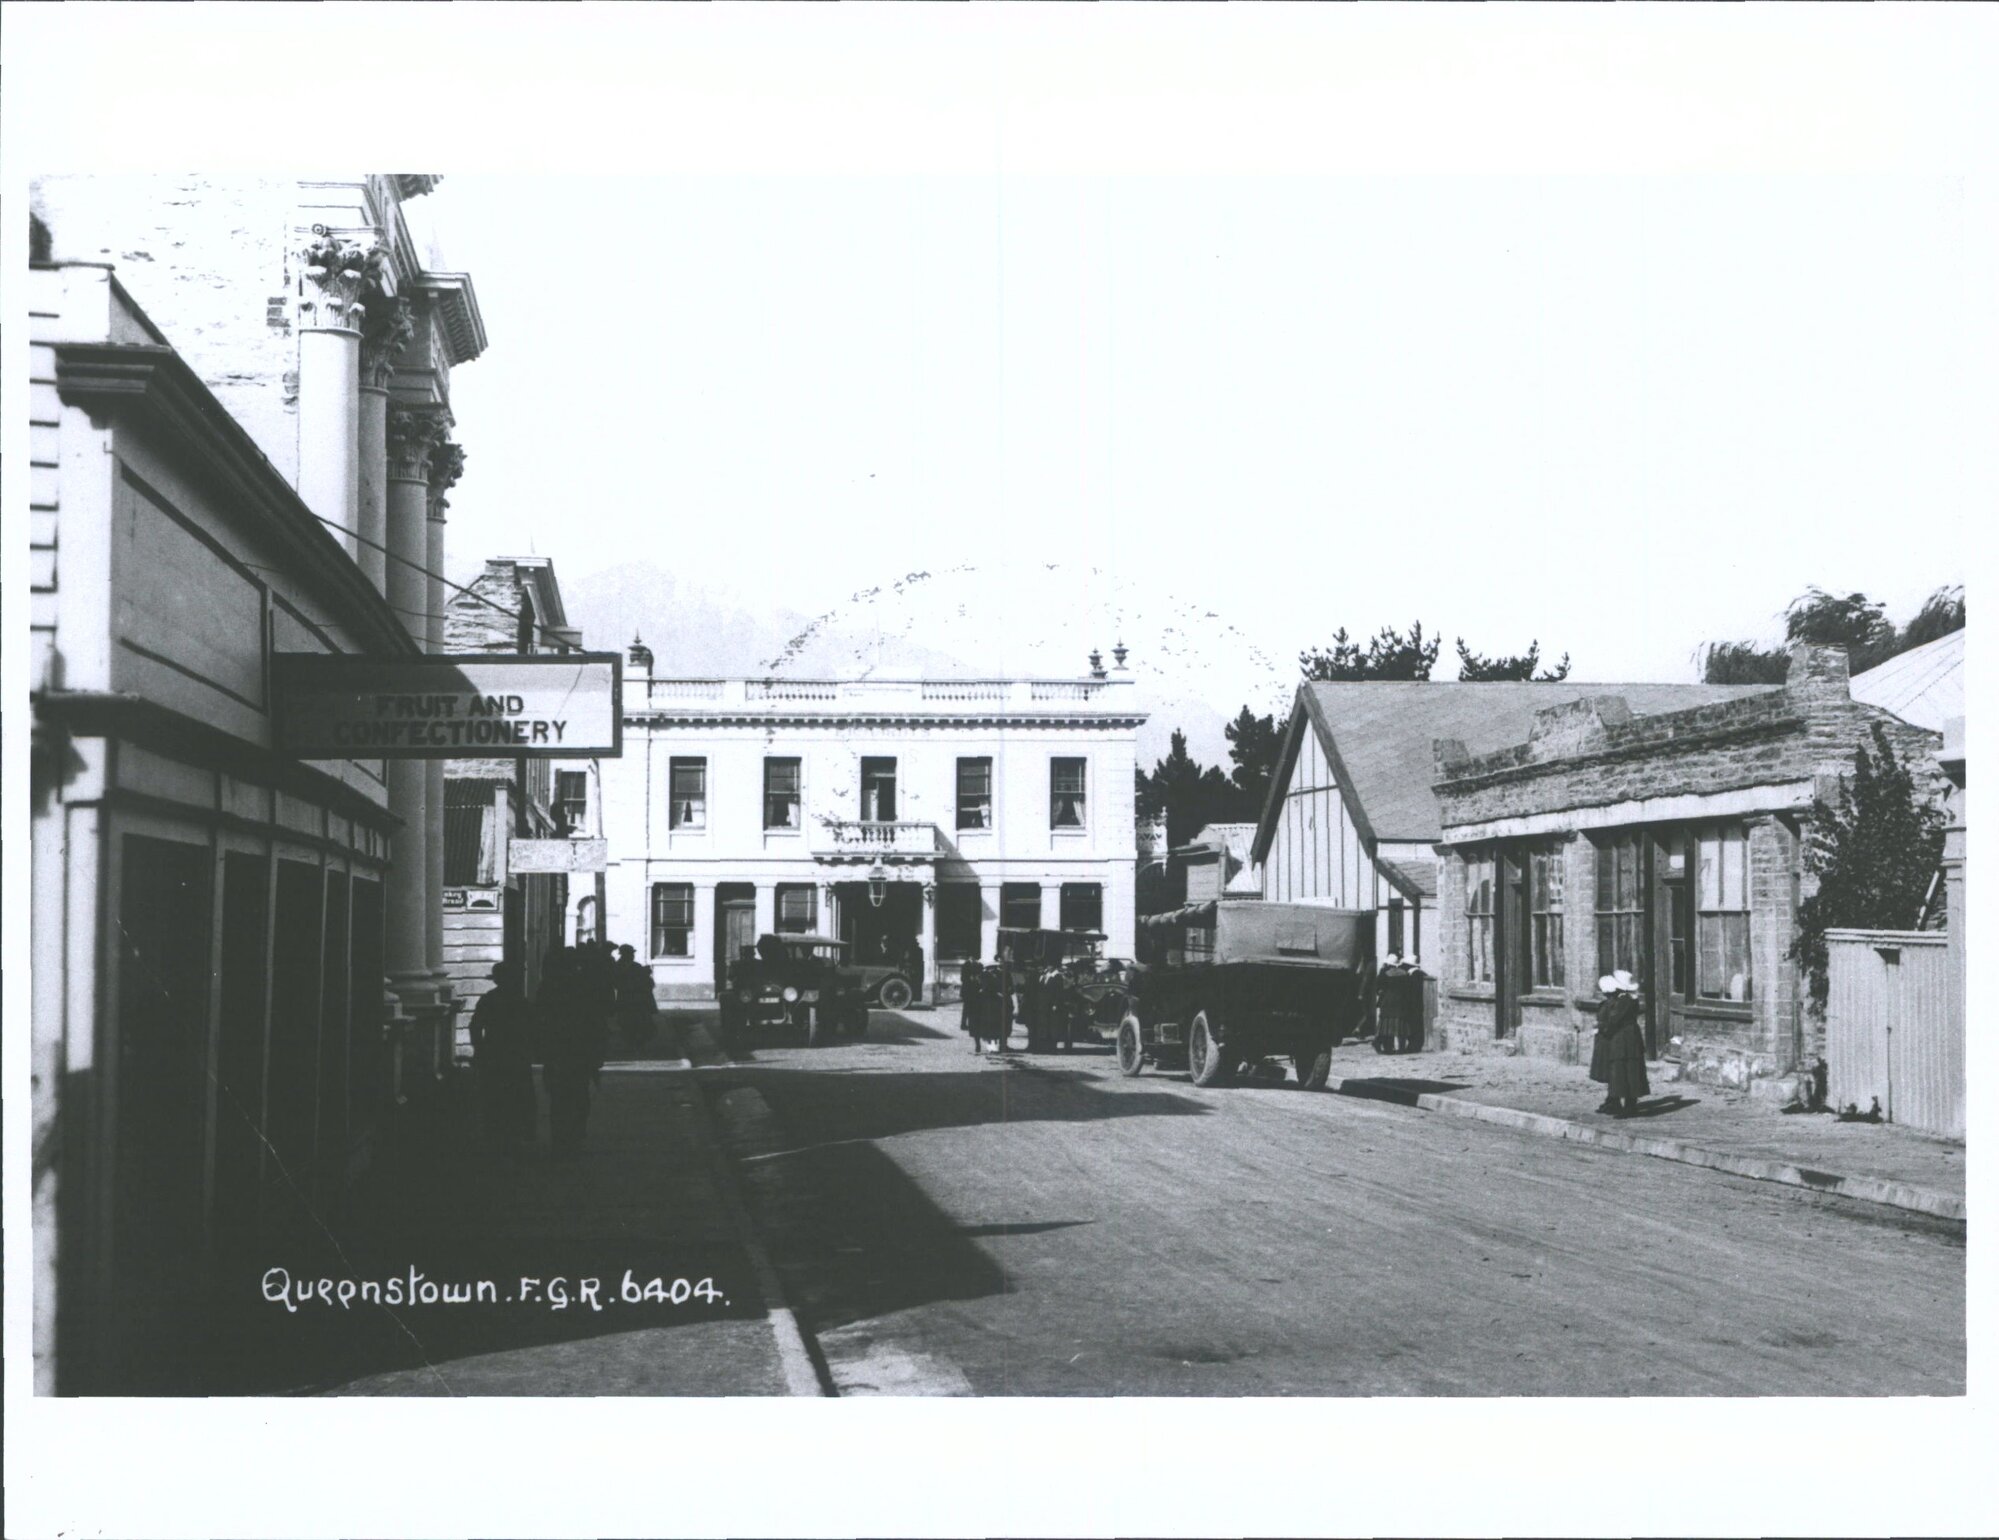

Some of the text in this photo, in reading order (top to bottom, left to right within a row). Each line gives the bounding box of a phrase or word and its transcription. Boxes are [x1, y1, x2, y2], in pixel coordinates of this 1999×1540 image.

[375, 694, 524, 717] FRUIT AND
[333, 720, 567, 745] CONFECTIONERY
